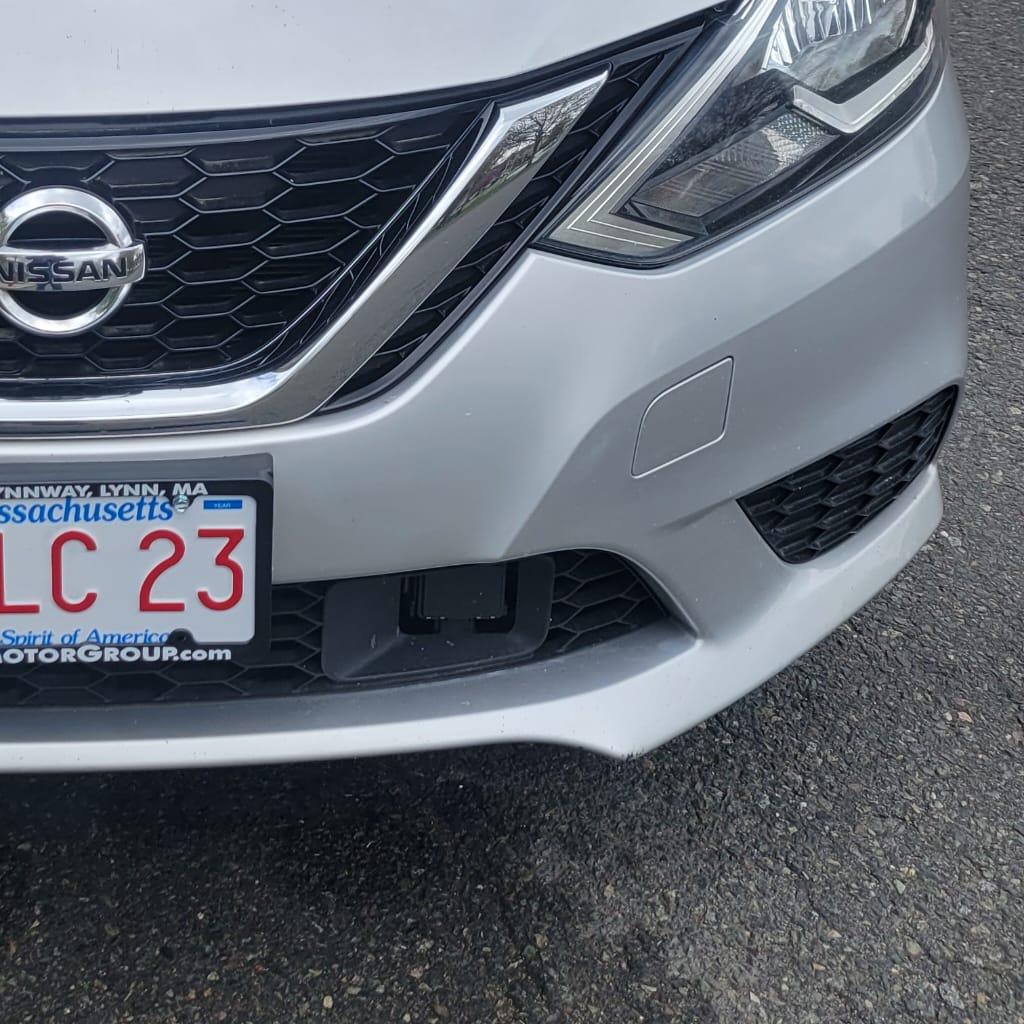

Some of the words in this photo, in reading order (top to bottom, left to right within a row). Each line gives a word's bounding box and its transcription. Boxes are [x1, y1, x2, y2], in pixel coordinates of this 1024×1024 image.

[100, 483, 165, 497] LYNN,
[172, 482, 208, 496] MA
[138, 528, 245, 612] 23
[0, 629, 53, 646] Spirit
[60, 629, 80, 645] of
